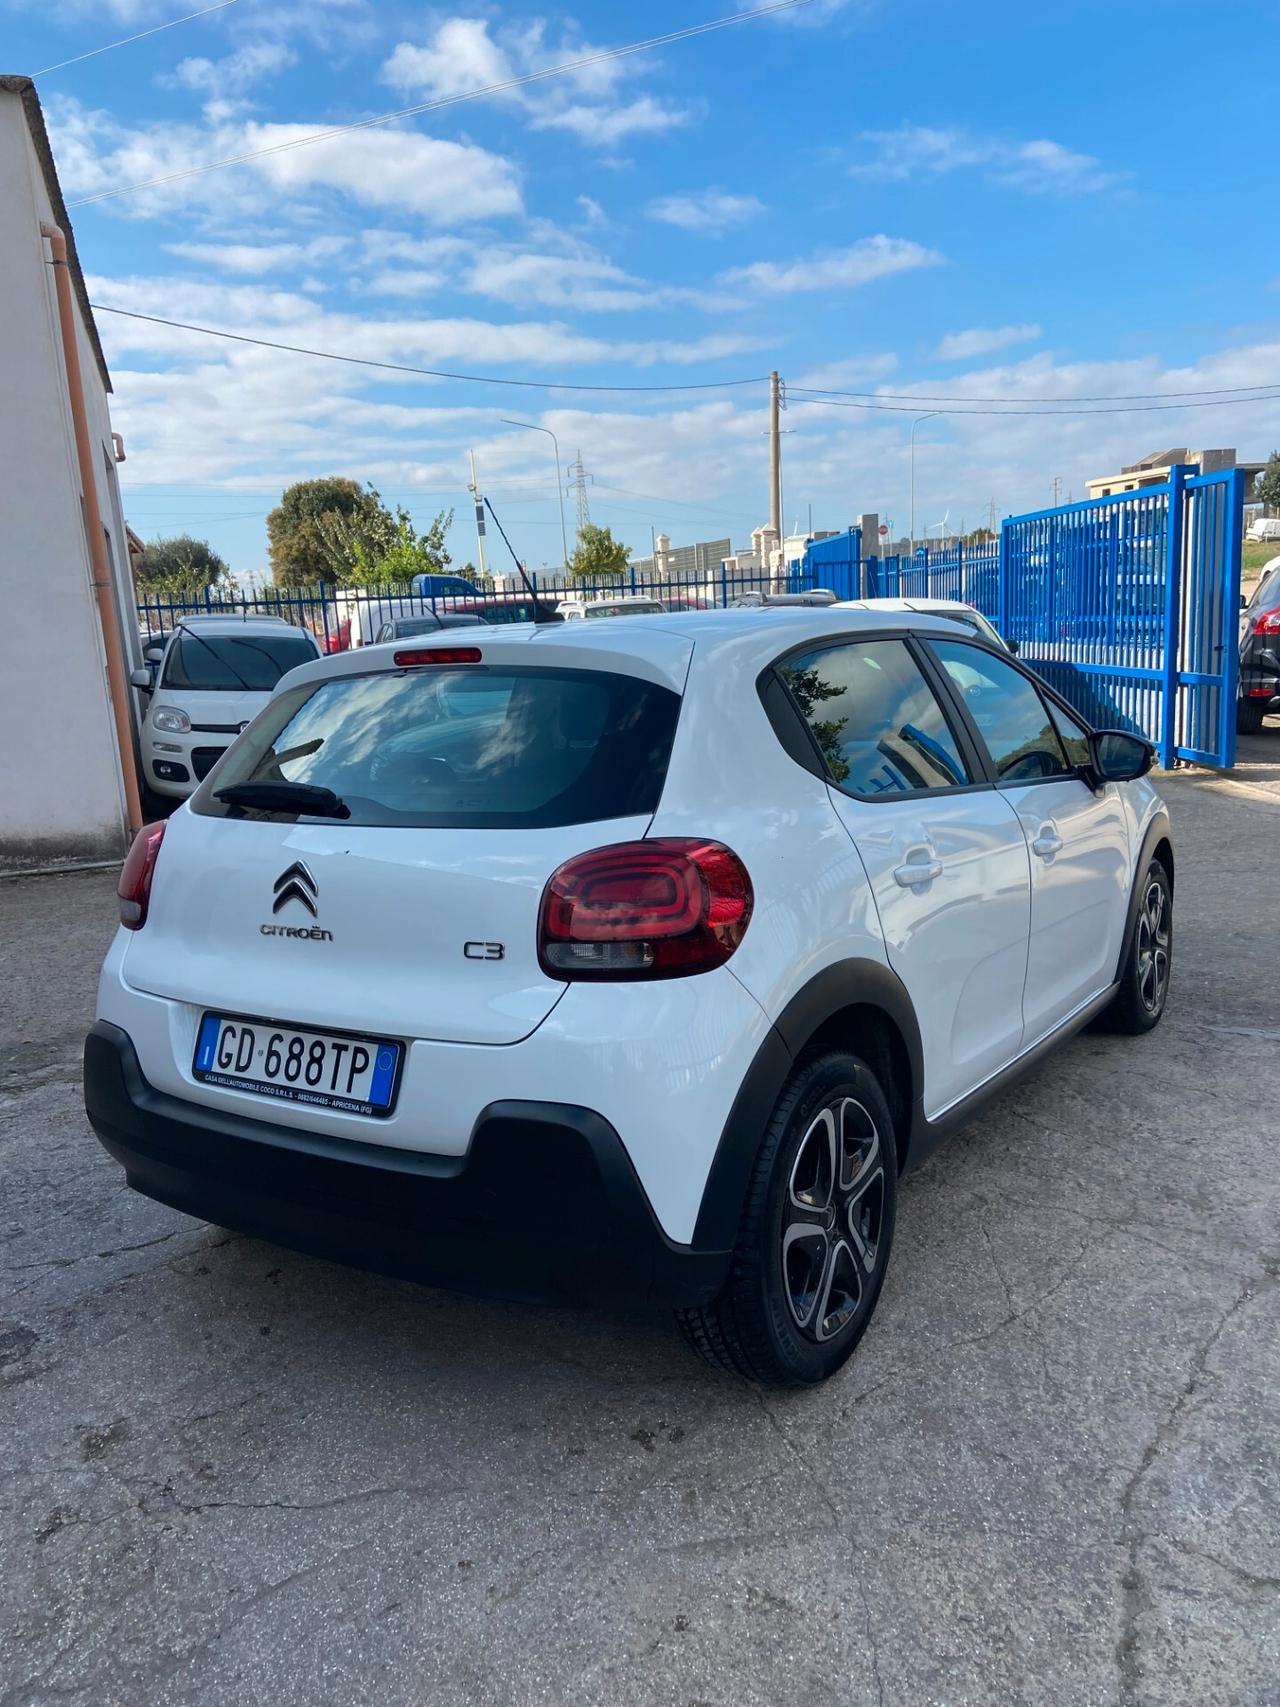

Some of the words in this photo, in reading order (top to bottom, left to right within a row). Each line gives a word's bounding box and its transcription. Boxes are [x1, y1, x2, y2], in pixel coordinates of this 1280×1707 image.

[463, 941, 505, 960] C3
[217, 1025, 256, 1073] GD
[264, 1033, 370, 1093] 688TP
[205, 1074, 218, 1082] CASA
[218, 1076, 260, 1091] DELL'AUTOMOBILE
[260, 1085, 275, 1095] COCO
[331, 1100, 360, 1112] APRICENA
[360, 1106, 373, 1115] (FG)
